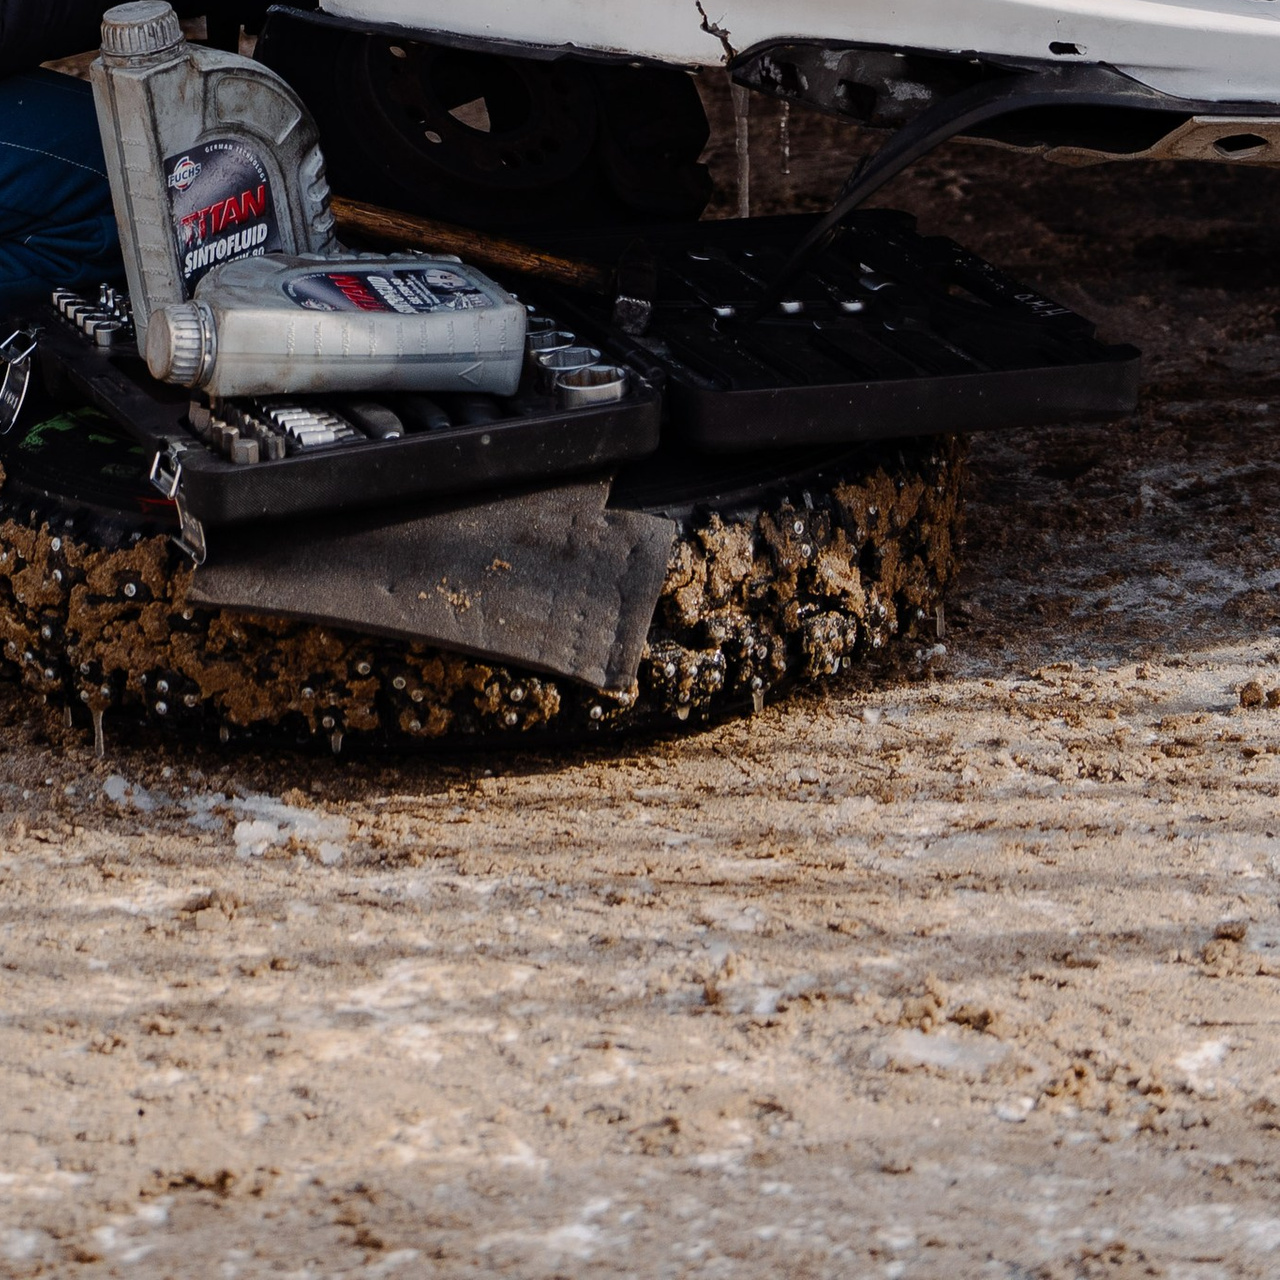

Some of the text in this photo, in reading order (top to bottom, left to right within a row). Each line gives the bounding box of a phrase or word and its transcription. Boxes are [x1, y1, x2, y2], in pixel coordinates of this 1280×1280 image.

[169, 163, 202, 187] FUCHS
[204, 142, 267, 183] GERMAN TECHNOLOGY
[178, 184, 266, 246] TITAN
[184, 222, 269, 274] SINTOFLUID
